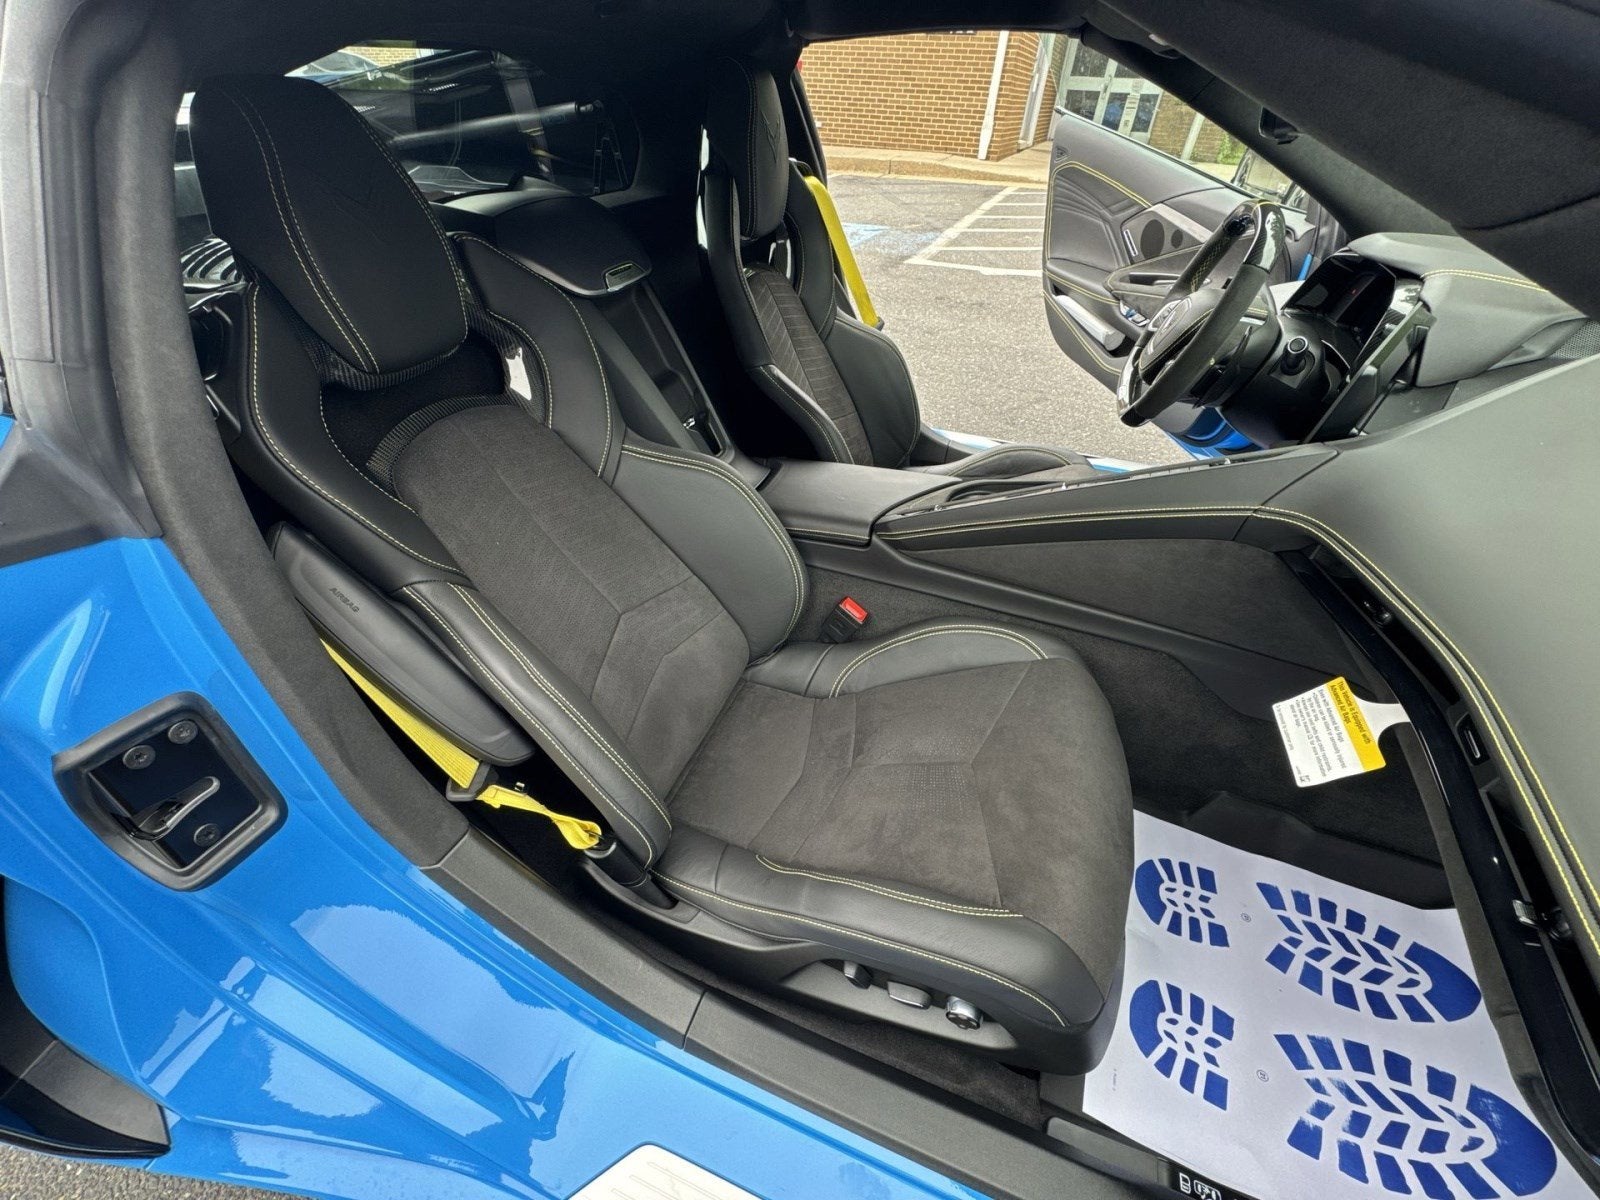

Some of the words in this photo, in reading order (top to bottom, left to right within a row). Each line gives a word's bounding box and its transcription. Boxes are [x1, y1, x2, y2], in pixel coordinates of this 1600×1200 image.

[328, 587, 360, 613] AIRBAG
[1329, 683, 1344, 705] Advanced
[1322, 698, 1330, 707] with
[1338, 703, 1347, 712] Air
[1325, 706, 1338, 725] Advanced
[1336, 680, 1346, 692] This
[1341, 690, 1353, 707] Vehicle
[1350, 711, 1366, 733] Equipped
[1361, 732, 1371, 744] with
[1341, 711, 1352, 724] Bags
[1335, 731, 1345, 742] Bags
